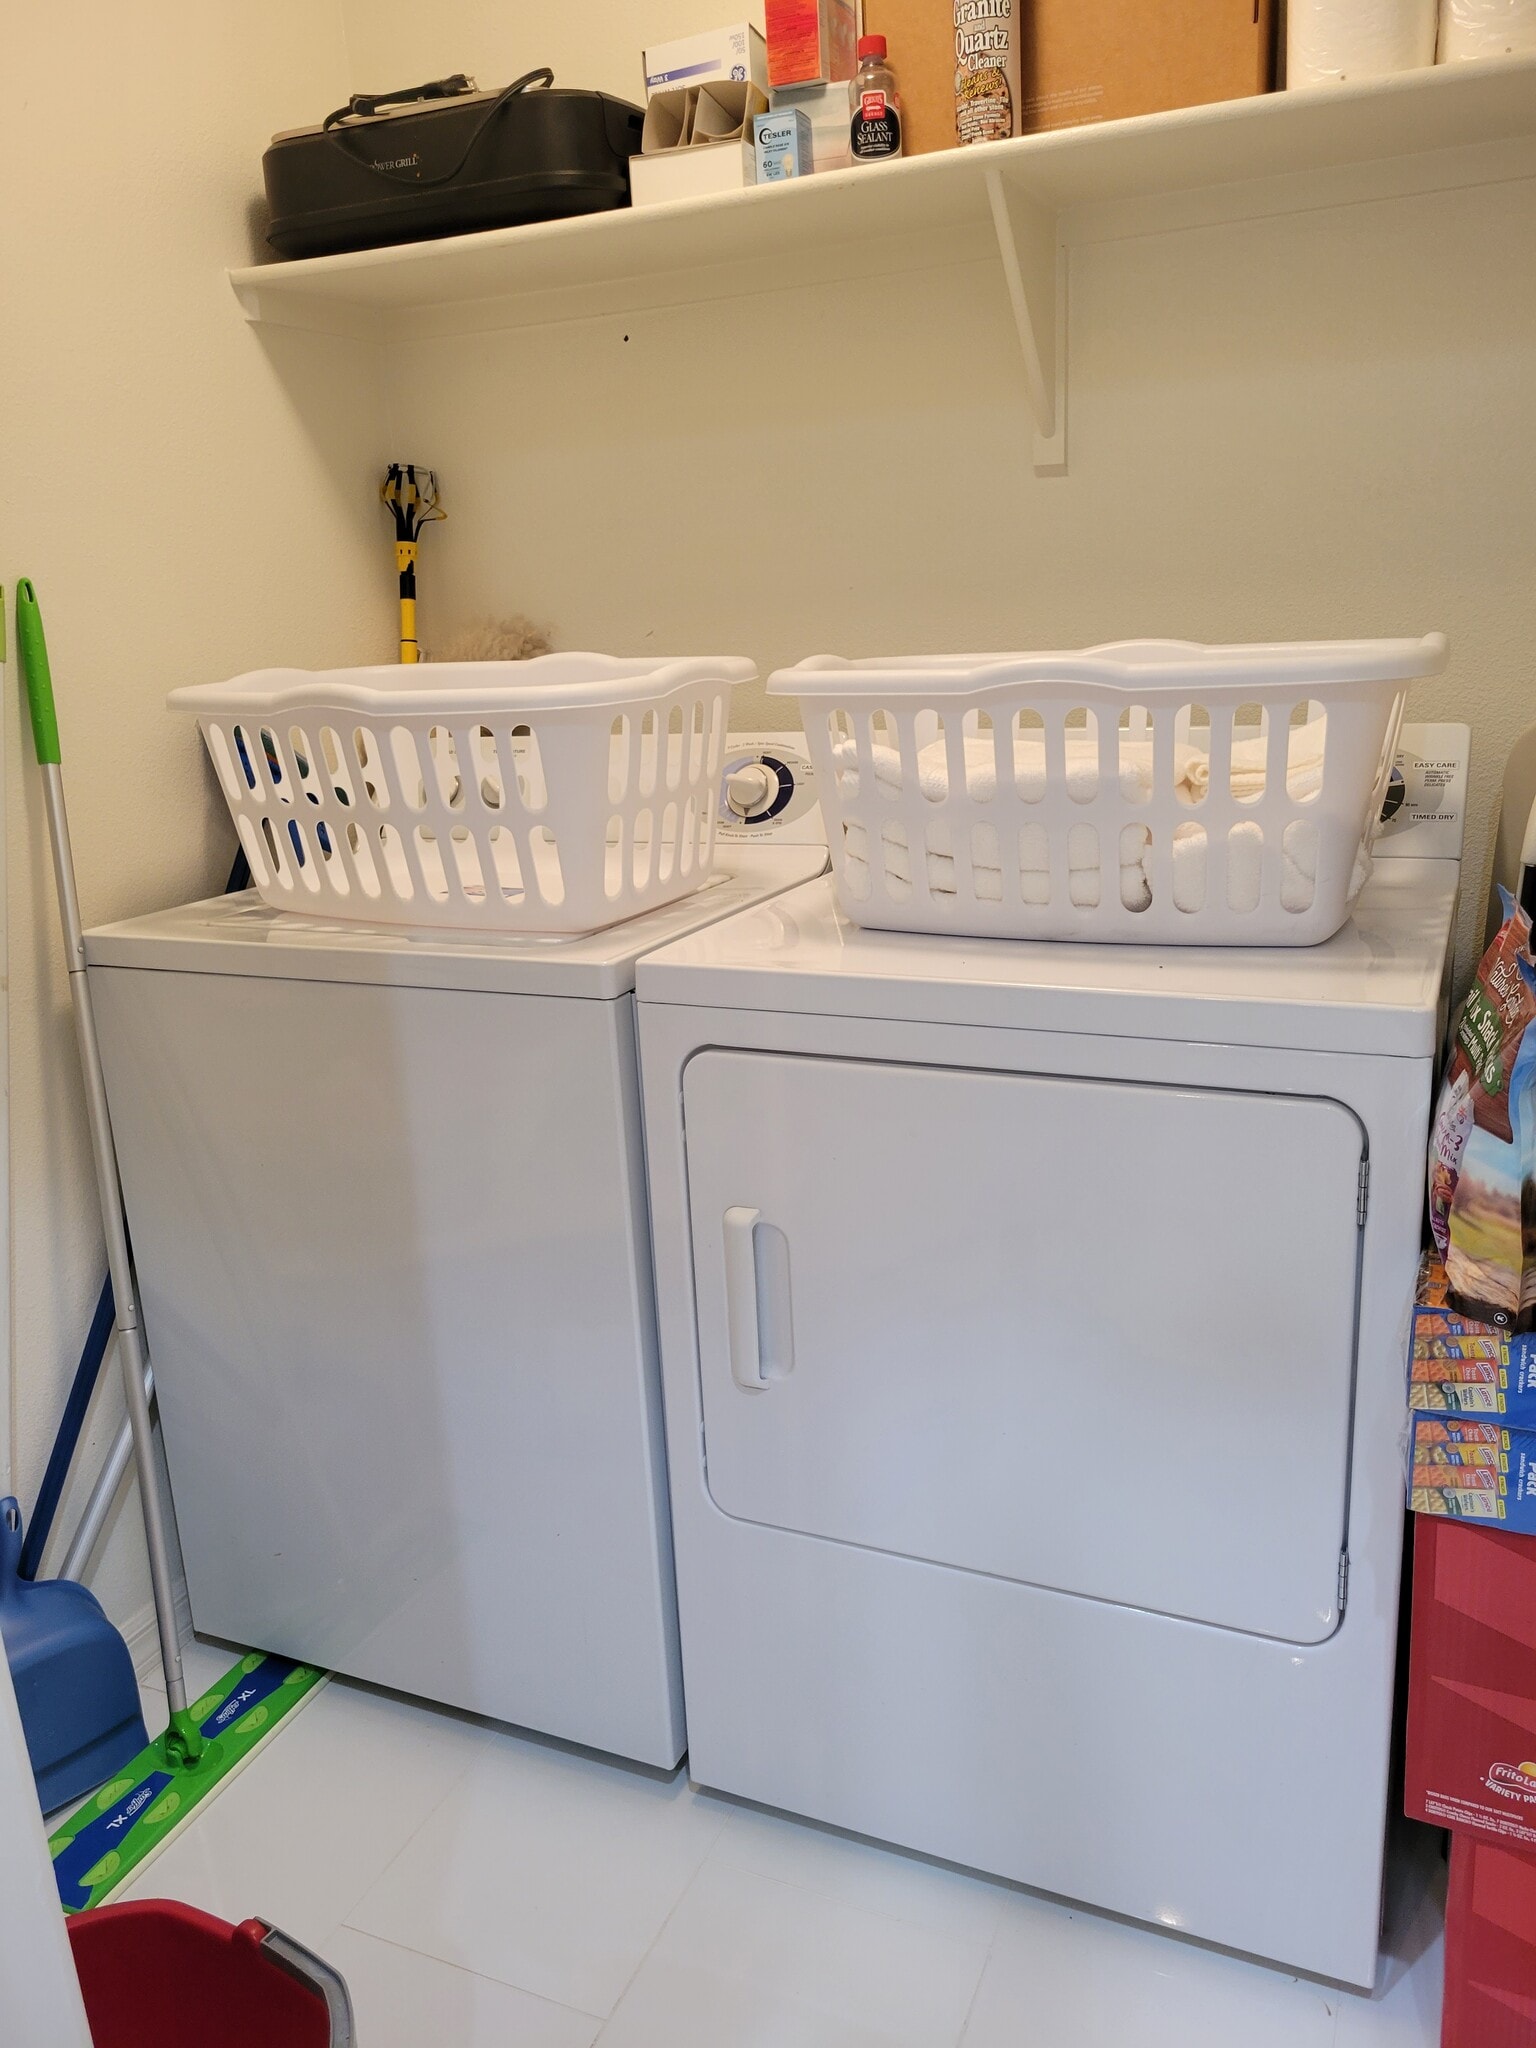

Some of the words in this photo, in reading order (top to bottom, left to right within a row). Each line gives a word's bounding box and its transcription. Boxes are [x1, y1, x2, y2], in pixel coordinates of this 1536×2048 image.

[954, 0, 1011, 27] Granite
[956, 25, 1009, 66] Quartz
[968, 55, 1007, 71] Cleaner
[761, 129, 792, 142] TESLER
[861, 121, 888, 133] GLASS
[857, 131, 893, 145] SEALANT
[395, 157, 418, 168] GRILL
[763, 160, 773, 168] 60
[1477, 1010, 1499, 1052] Snack
[1440, 1144, 1457, 1165] Mix
[1519, 1344, 1527, 1371] sandwich
[1517, 1370, 1525, 1394] crackers
[1479, 1386, 1492, 1407] Lance
[1526, 1461, 1536, 1496] Pack
[1516, 1478, 1524, 1501] crackers
[1479, 1493, 1492, 1512] Lance
[216, 1699, 240, 1724] Swiffer
[237, 1688, 257, 1701] XL
[1495, 1766, 1523, 1782] Frito
[1485, 1779, 1522, 1801] VARIETY
[126, 1787, 153, 1816] Swiffer
[106, 1814, 128, 1830] XL
